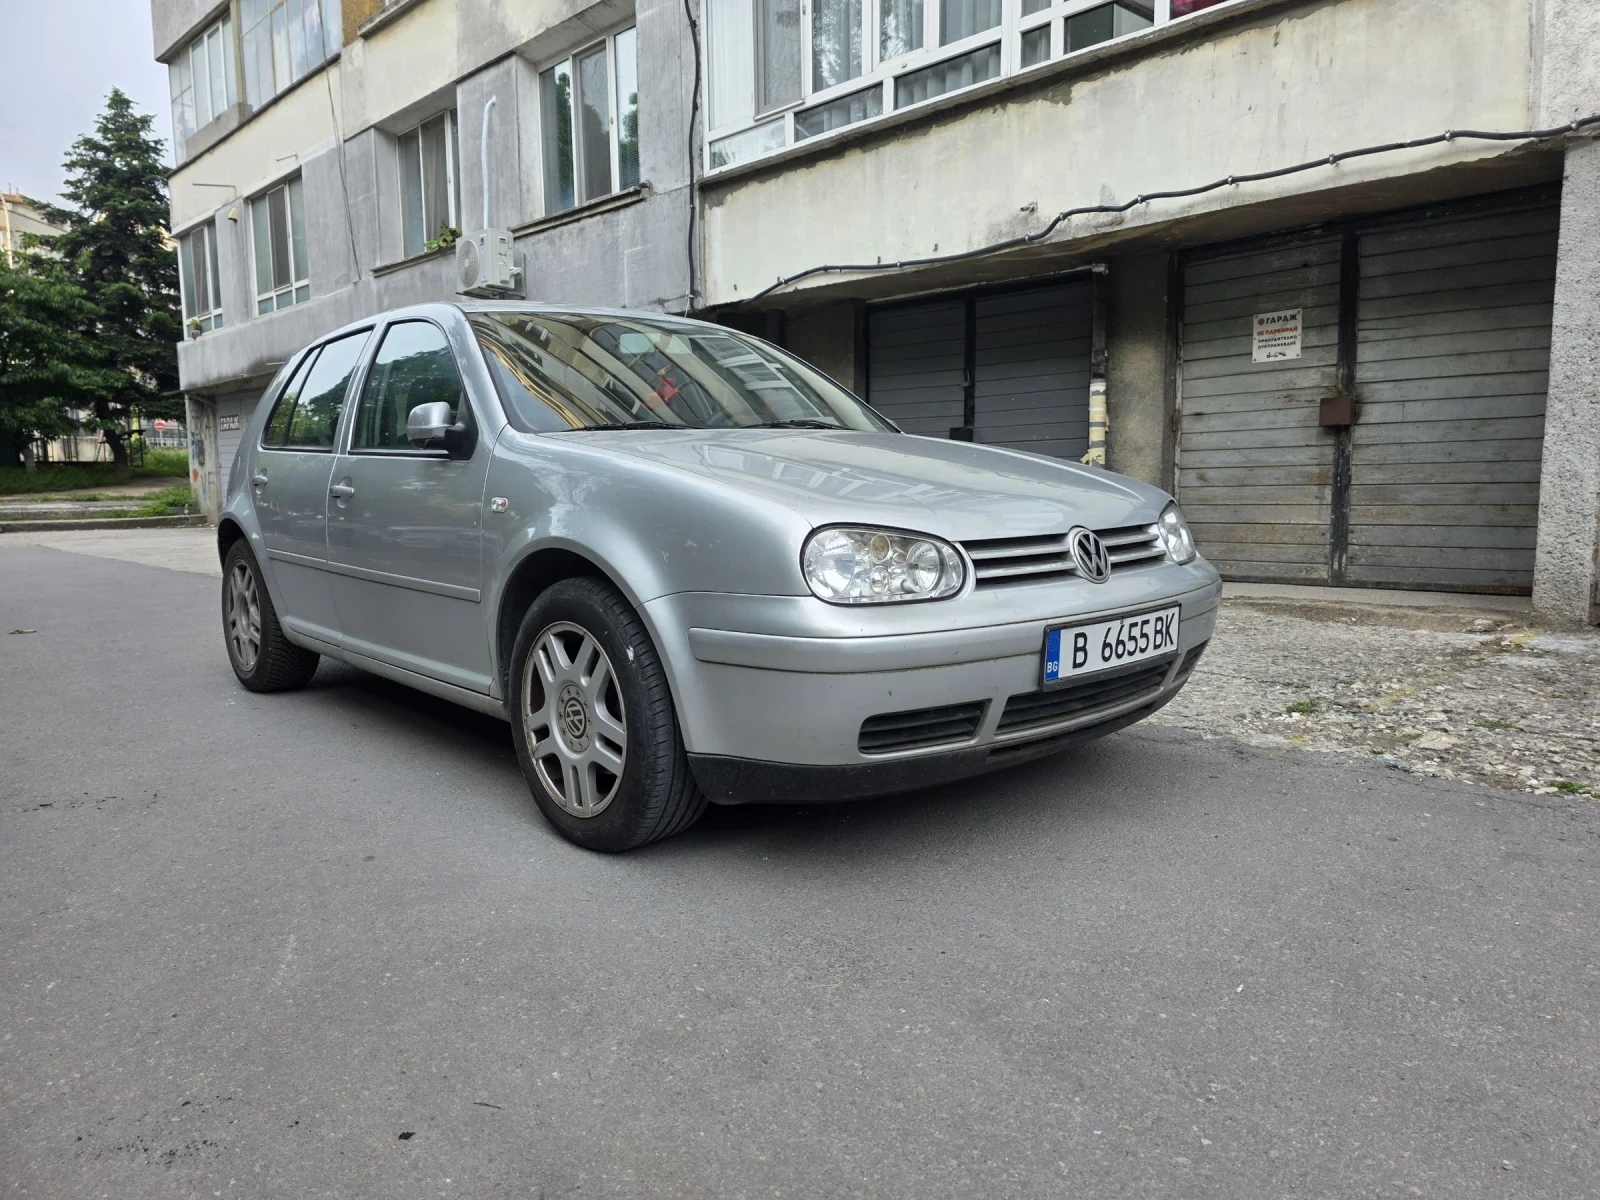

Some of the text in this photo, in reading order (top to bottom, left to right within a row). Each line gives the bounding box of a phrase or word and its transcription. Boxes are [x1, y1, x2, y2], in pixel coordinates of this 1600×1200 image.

[1266, 314, 1297, 324] ГАРАЖ
[1265, 325, 1298, 336] ПАРКИРАЙ
[1072, 632, 1088, 669] B
[1046, 661, 1058, 673] BG
